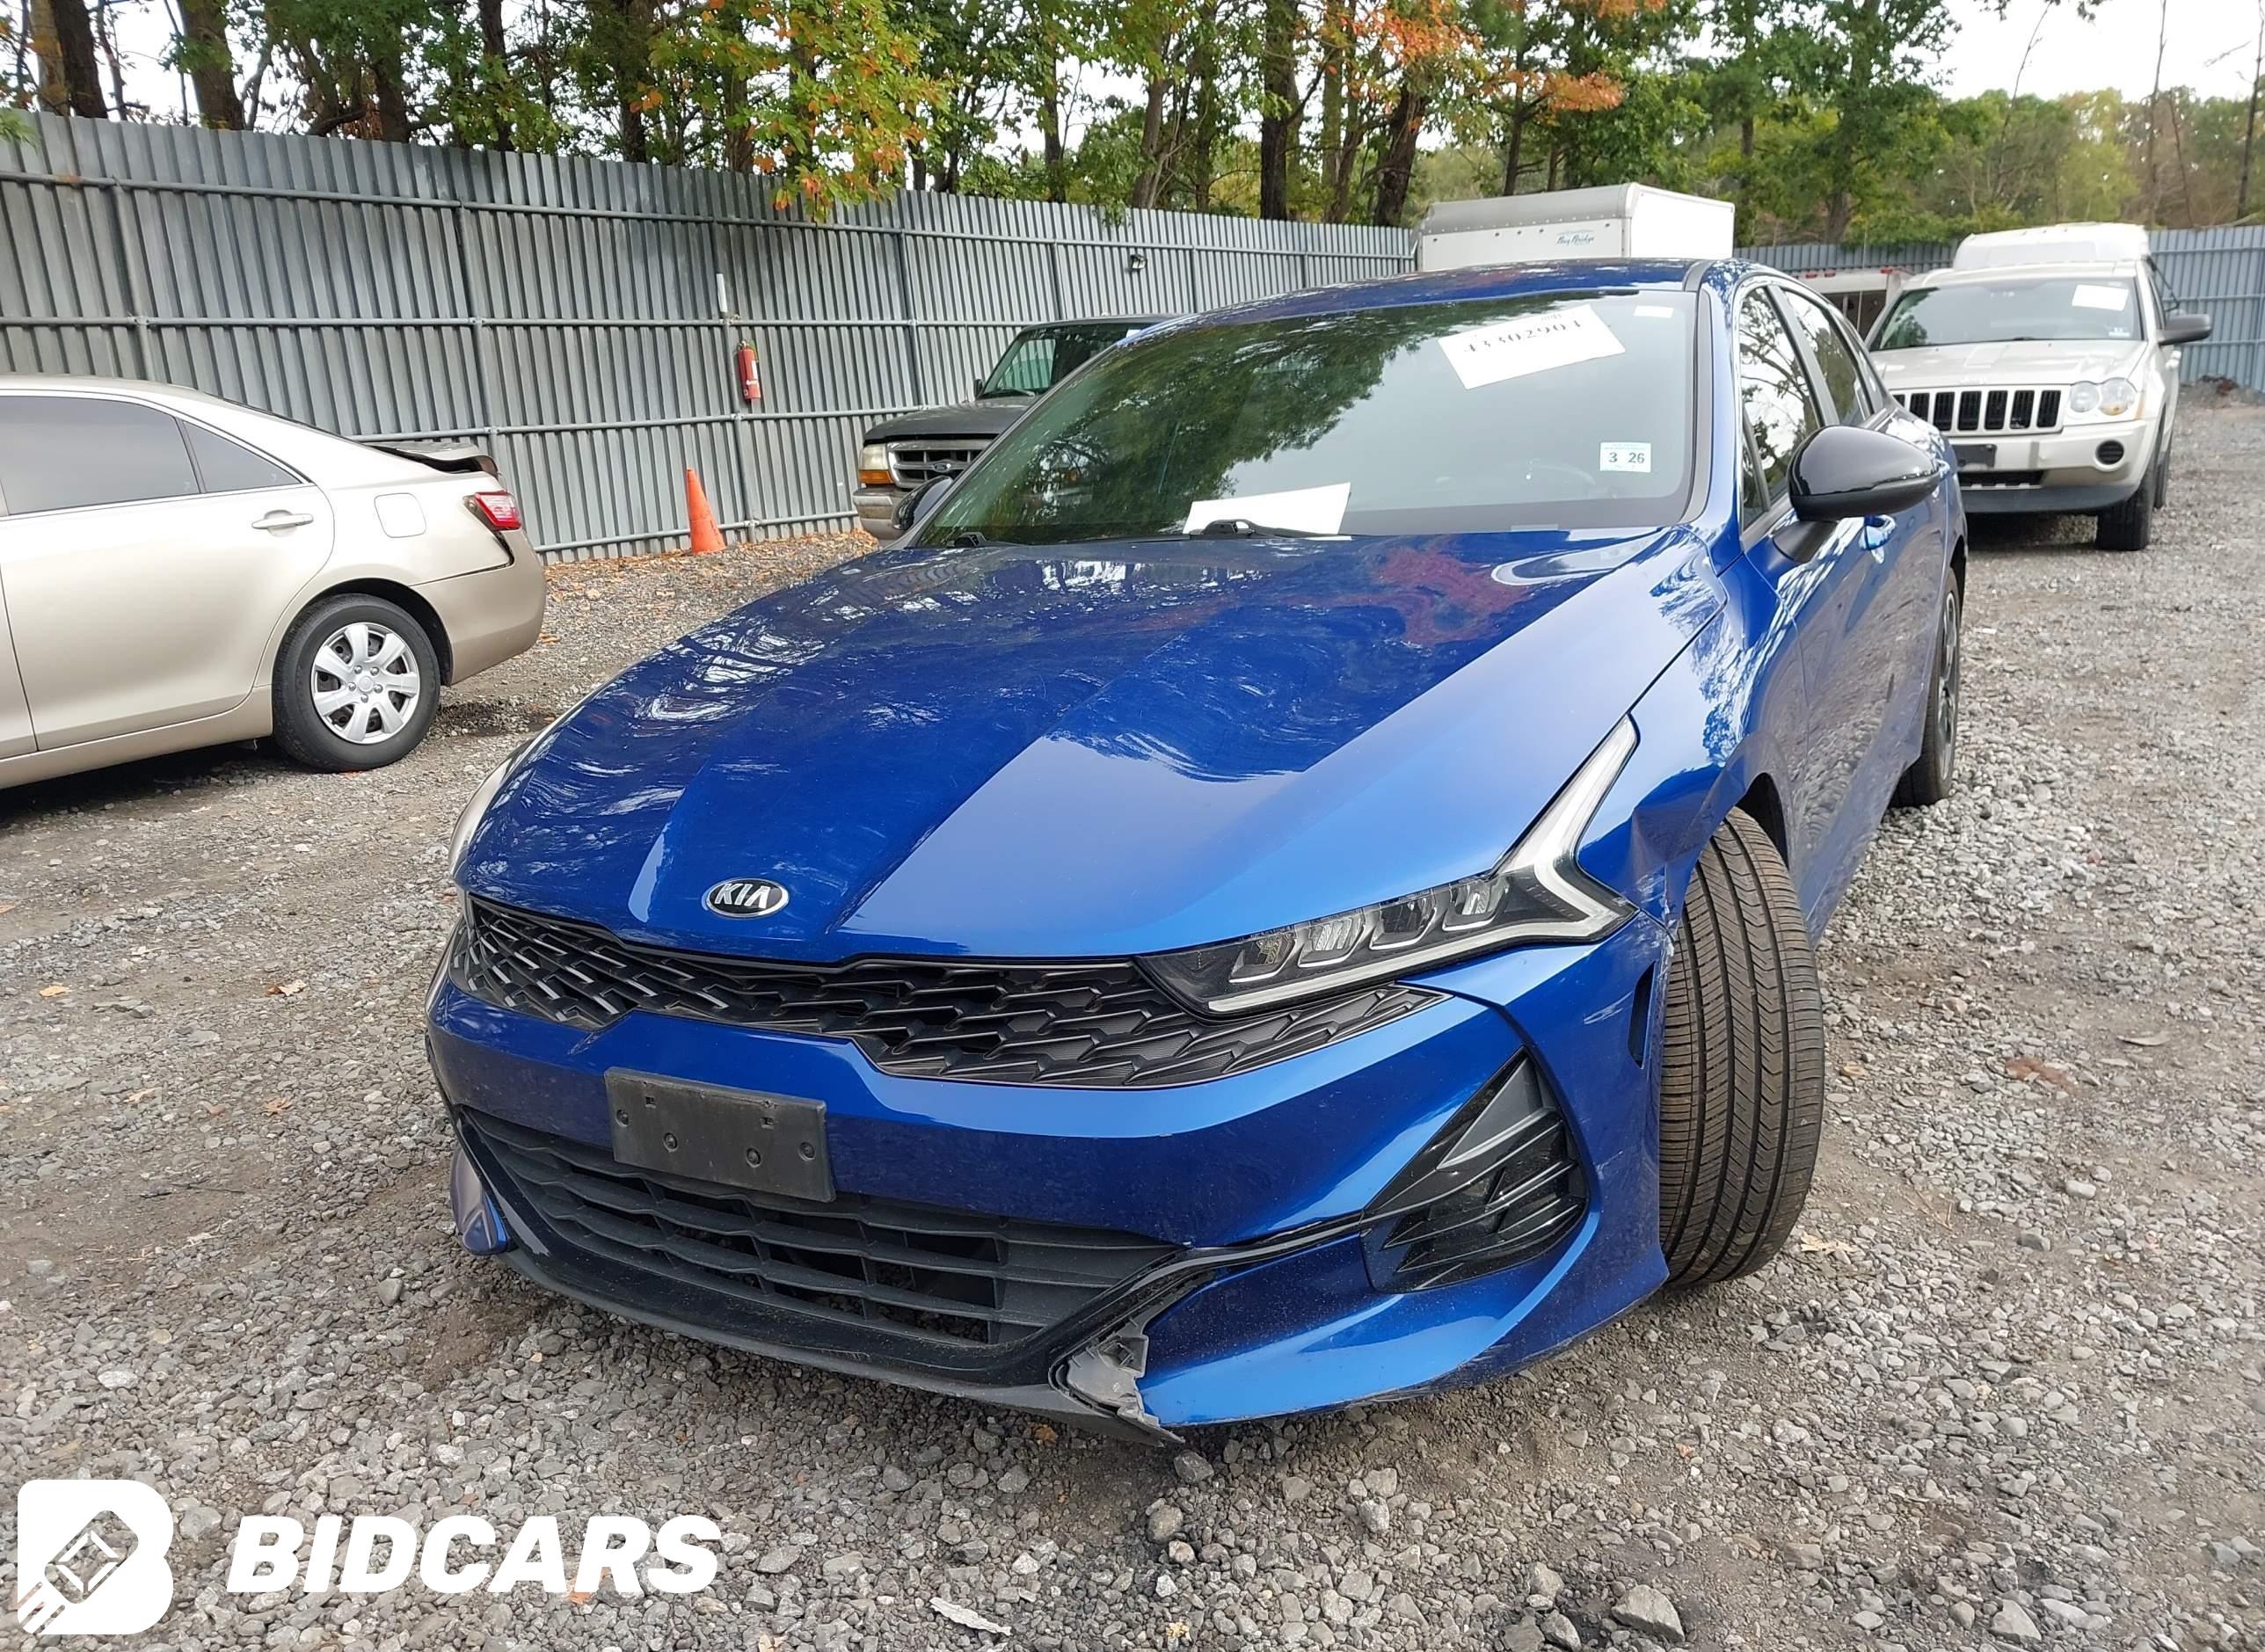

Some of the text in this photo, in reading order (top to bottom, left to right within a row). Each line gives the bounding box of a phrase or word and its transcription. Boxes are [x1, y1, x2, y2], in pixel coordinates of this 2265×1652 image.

[1608, 451, 1645, 464] 3 26
[714, 883, 771, 909] KIA
